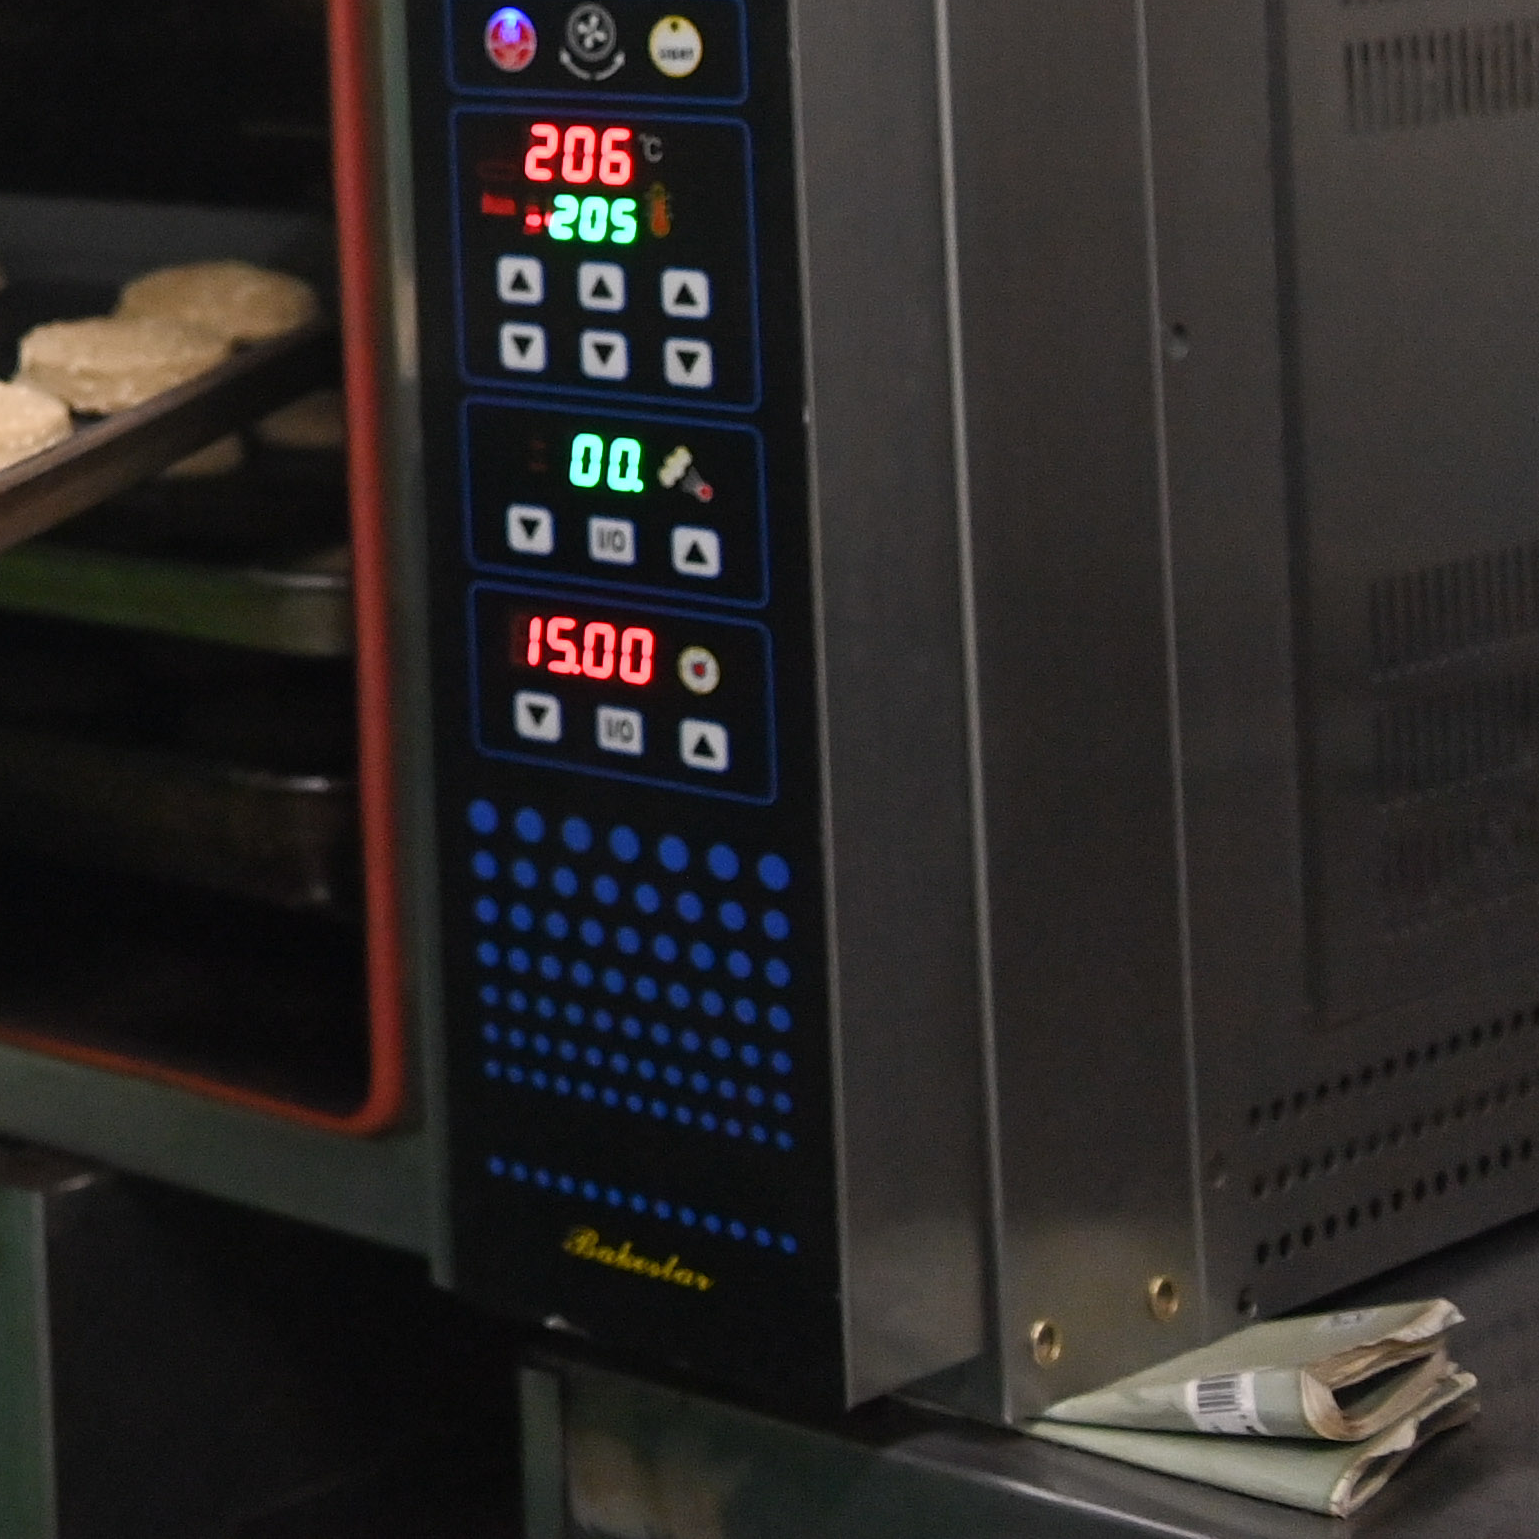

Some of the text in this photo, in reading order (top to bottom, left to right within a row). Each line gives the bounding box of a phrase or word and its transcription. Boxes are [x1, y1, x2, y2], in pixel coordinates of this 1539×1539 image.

[524, 124, 633, 186] 206
[548, 194, 638, 244] 205
[527, 616, 654, 686] 15.00
